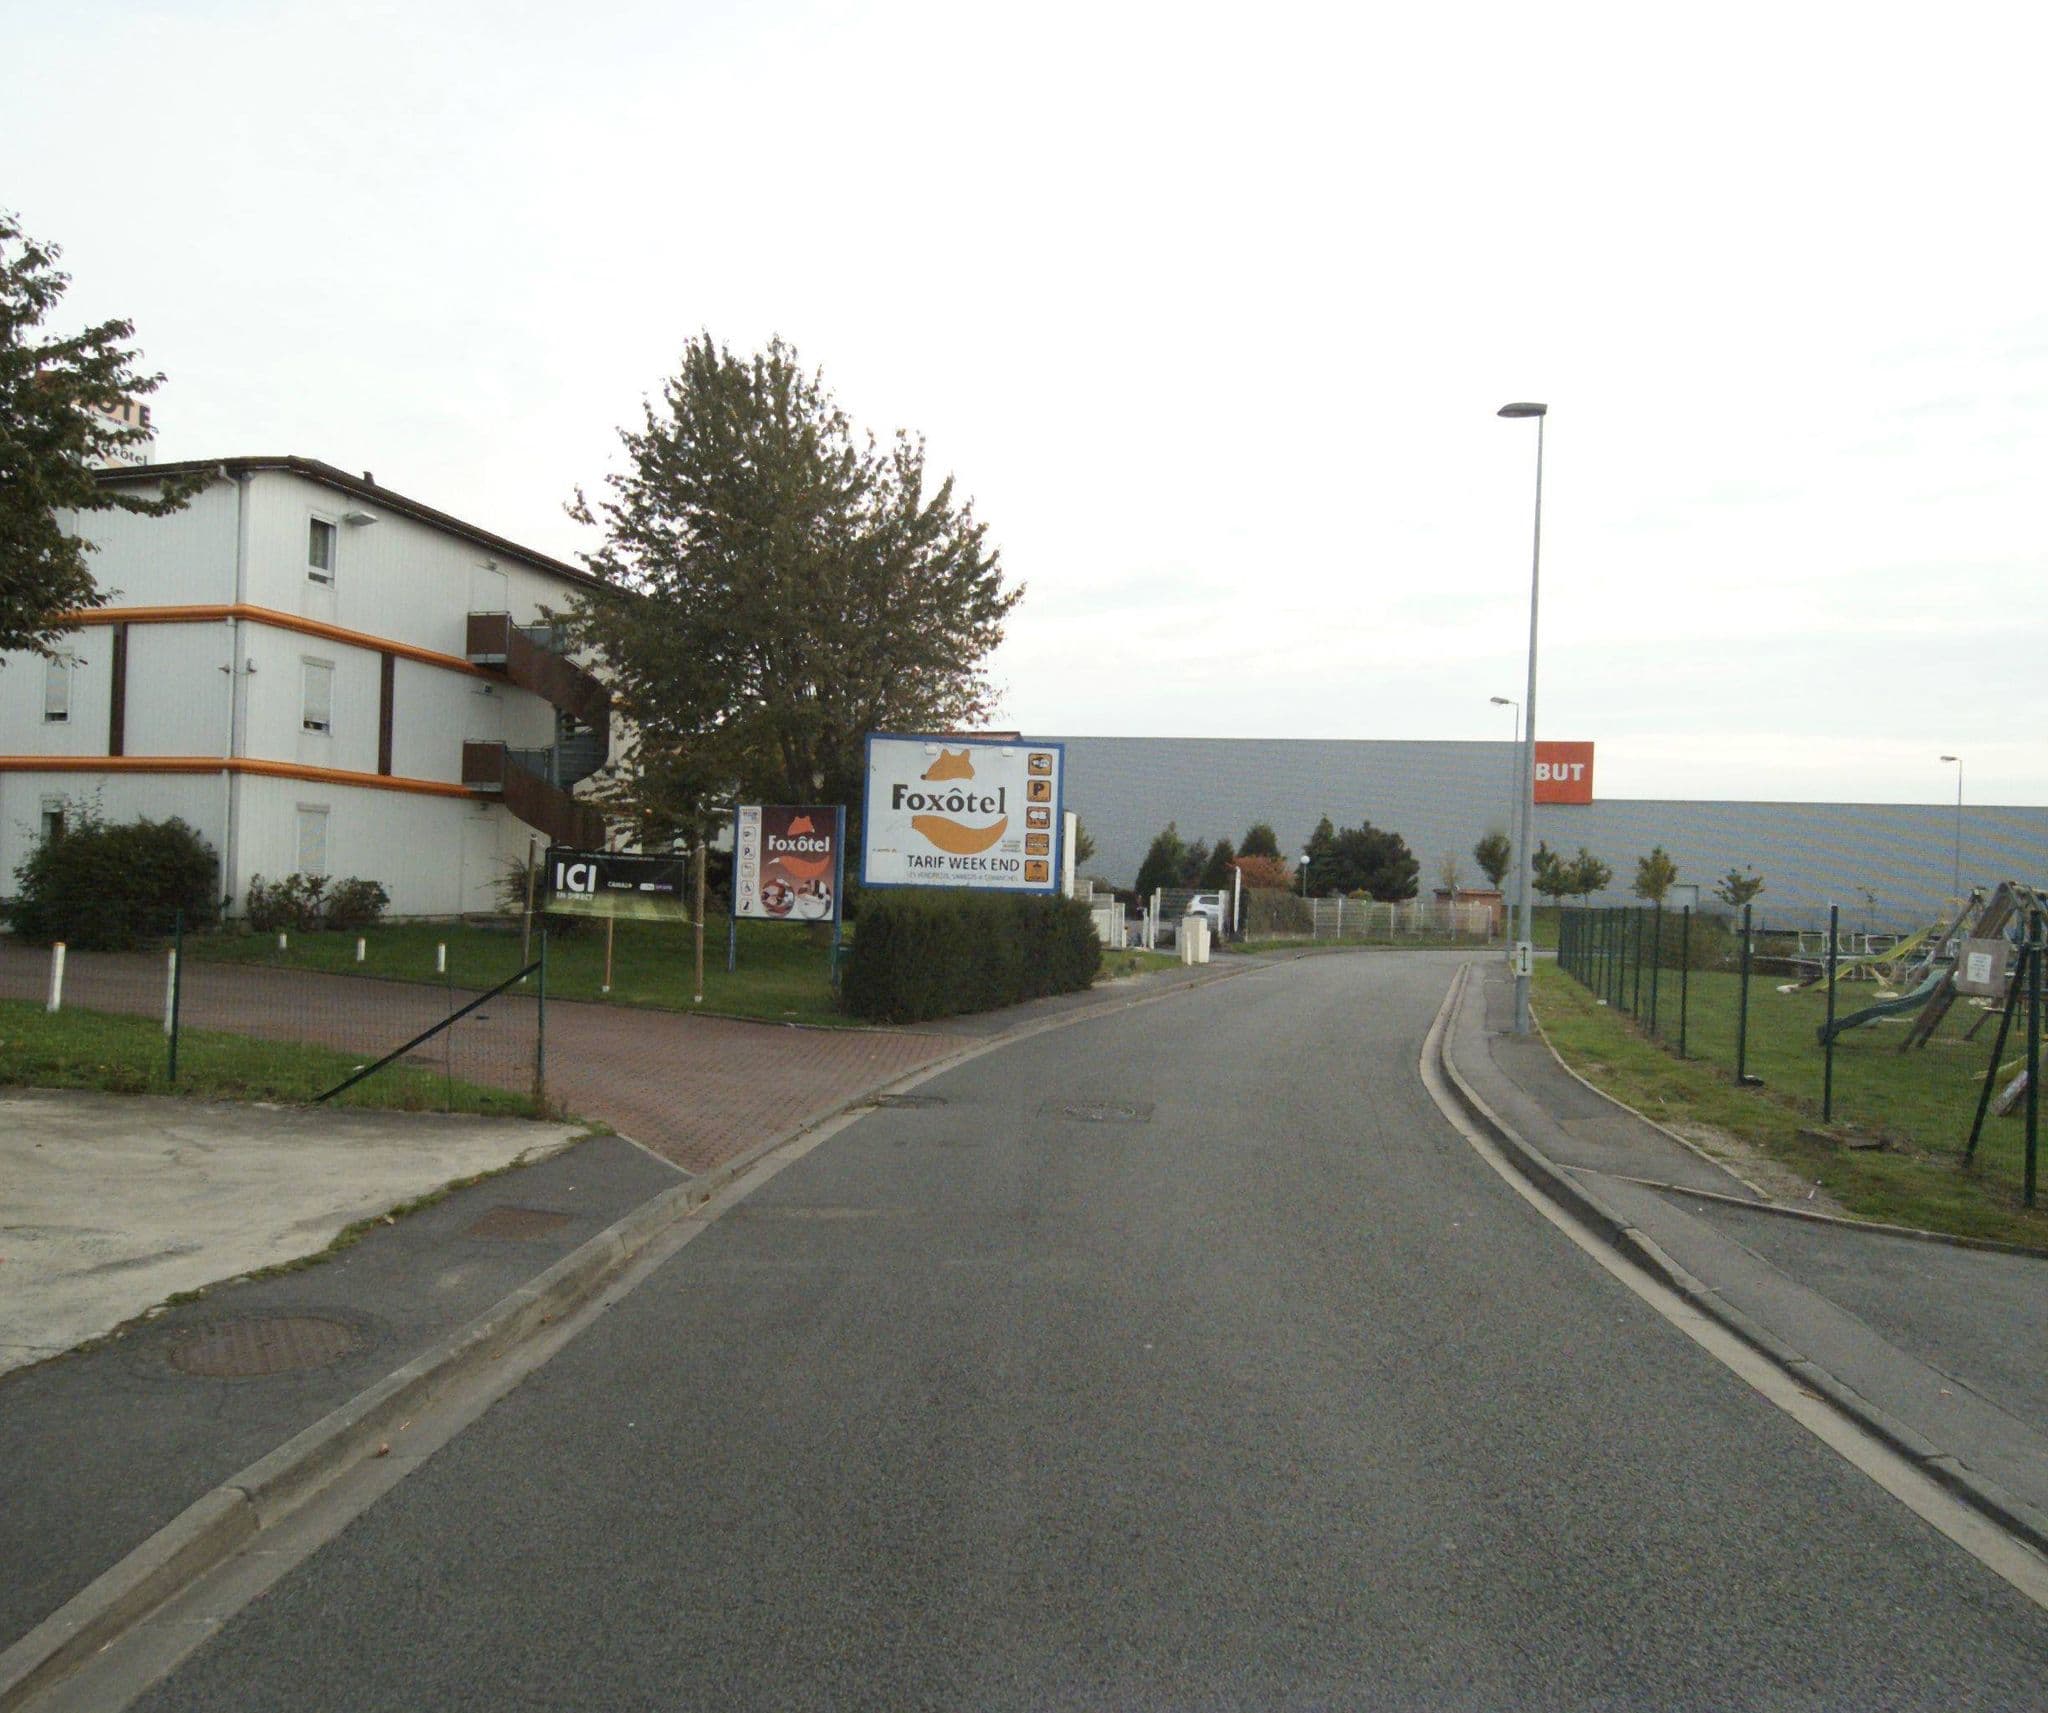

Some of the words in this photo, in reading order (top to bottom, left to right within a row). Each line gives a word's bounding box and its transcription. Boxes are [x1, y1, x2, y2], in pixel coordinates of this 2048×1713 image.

[1535, 763, 1584, 781] BUT
[891, 783, 1007, 814] Foxôtel
[768, 835, 830, 852] Foxôtel
[907, 855, 945, 868] TARIF
[949, 857, 987, 870] WEEK
[991, 858, 1020, 872] END
[556, 862, 597, 892] ICI
